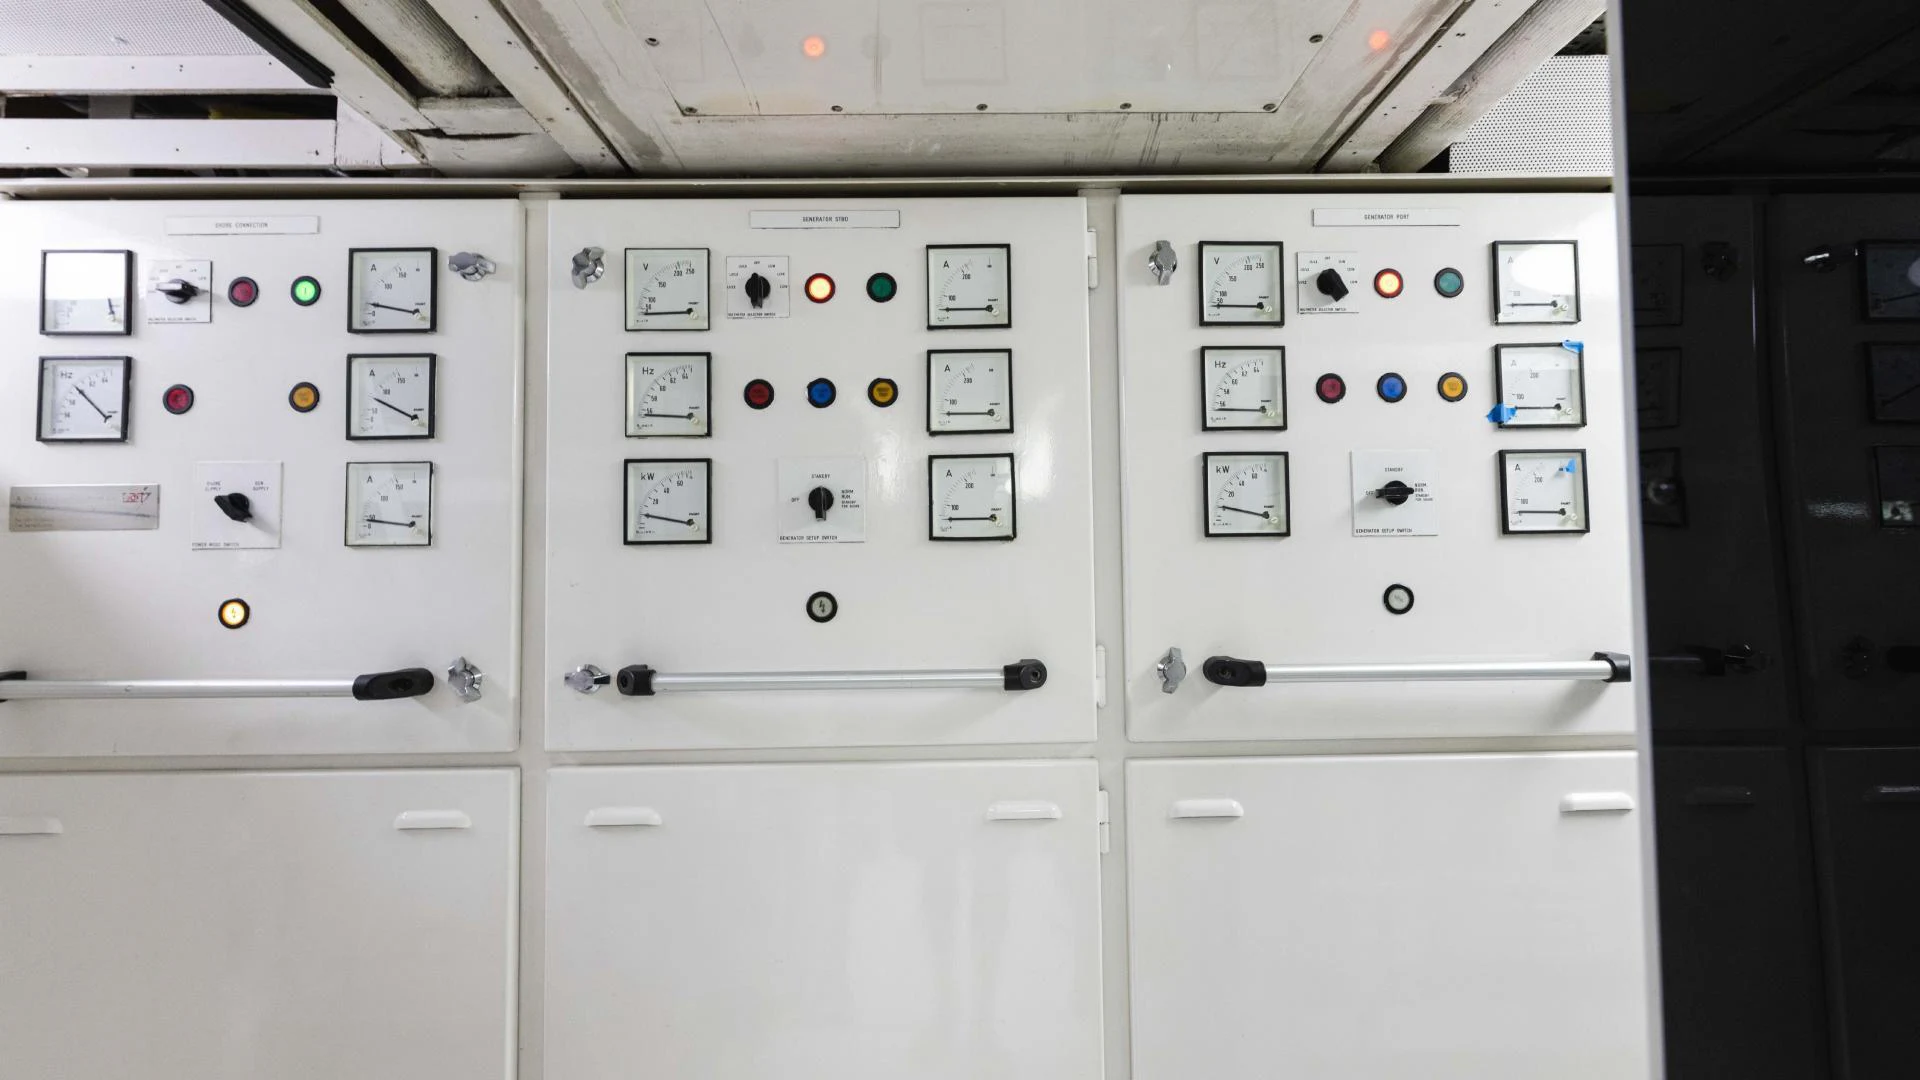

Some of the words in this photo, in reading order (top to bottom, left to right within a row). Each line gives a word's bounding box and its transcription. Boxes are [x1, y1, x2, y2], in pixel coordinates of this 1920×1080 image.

[942, 259, 950, 269] A
[1213, 256, 1220, 265] V
[1507, 255, 1514, 264] A
[370, 263, 377, 272] A
[642, 263, 649, 272] V
[1214, 360, 1227, 369] Hz
[1510, 359, 1517, 367] A
[368, 368, 376, 377] A
[642, 366, 655, 375] Hz
[944, 364, 951, 373] A
[60, 371, 73, 379] Hz
[1215, 465, 1230, 474] kW
[1514, 463, 1521, 472] A
[640, 472, 655, 481] kW
[945, 468, 953, 478] A
[366, 475, 373, 484] A
